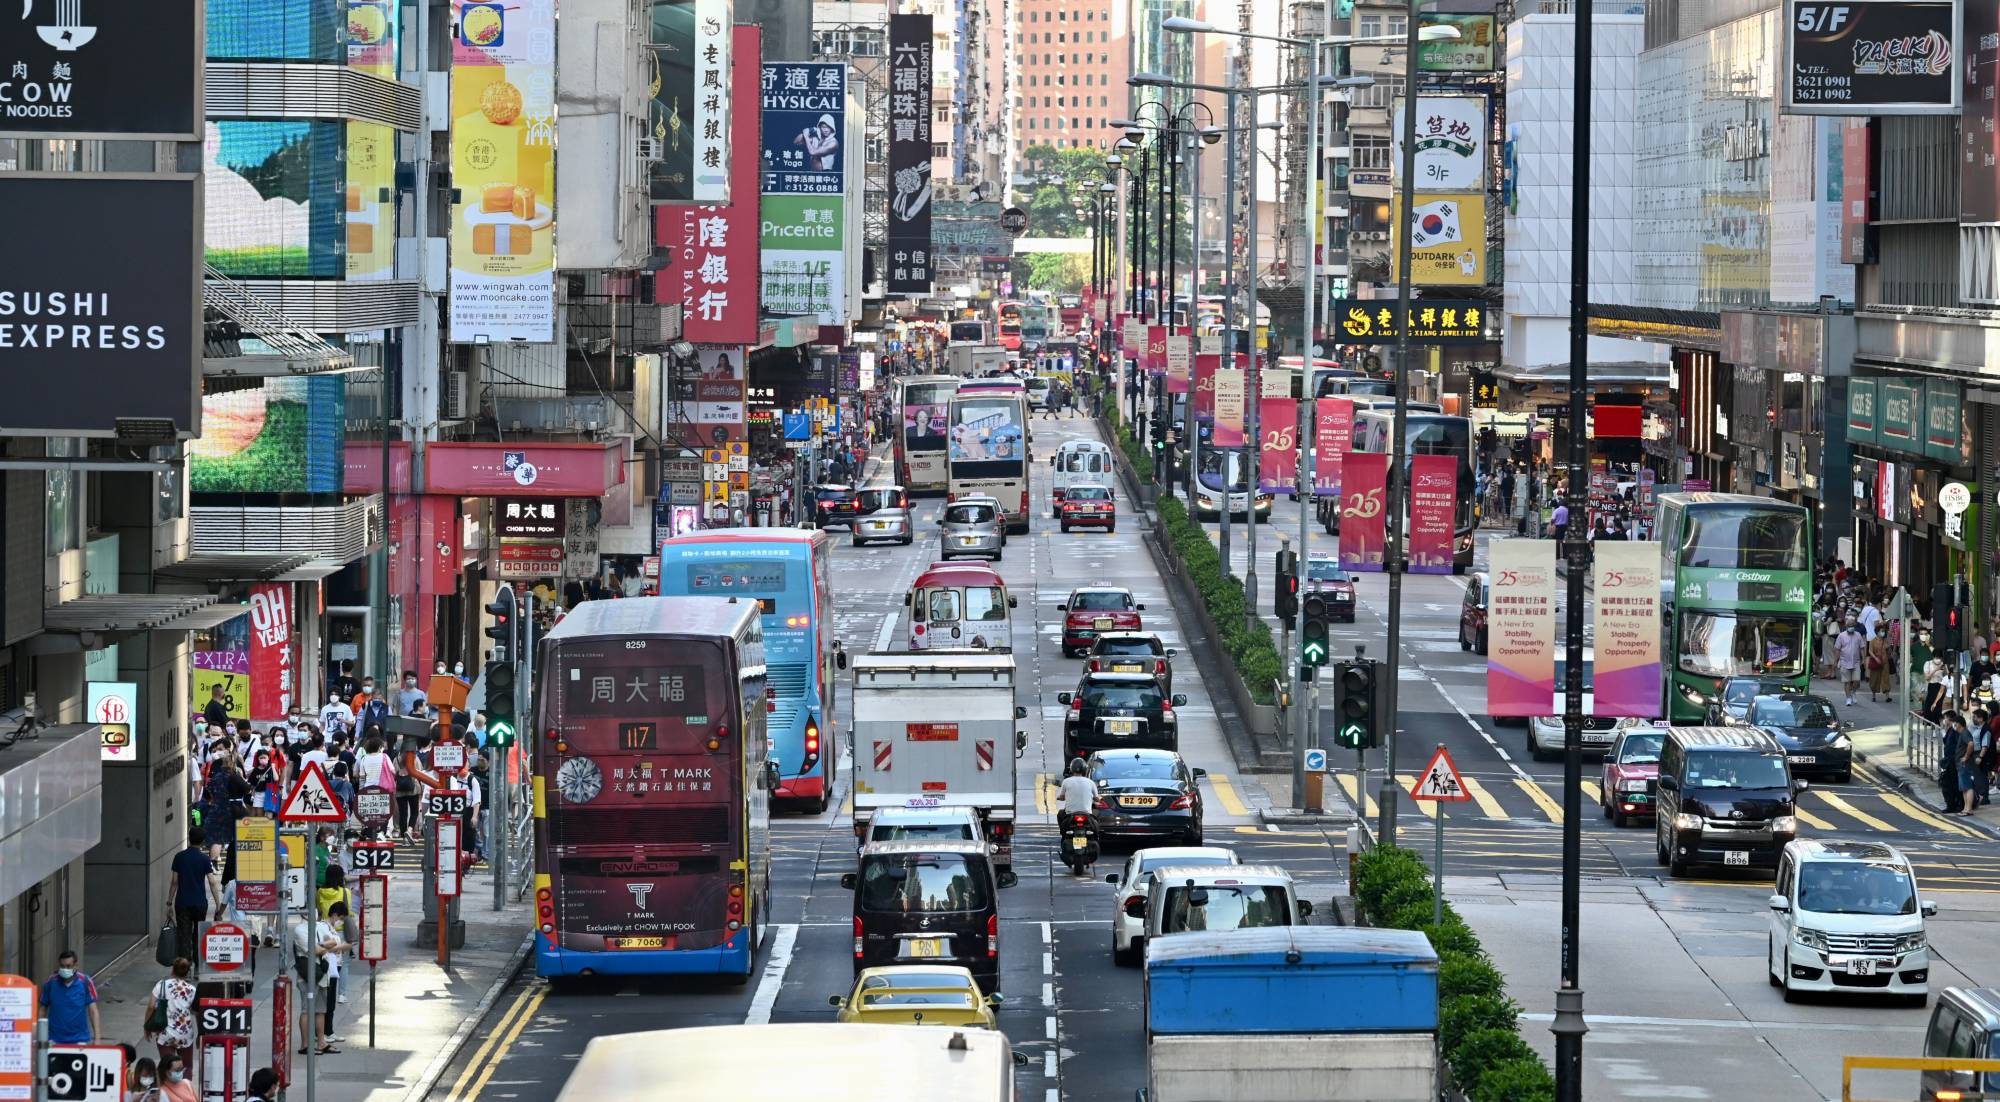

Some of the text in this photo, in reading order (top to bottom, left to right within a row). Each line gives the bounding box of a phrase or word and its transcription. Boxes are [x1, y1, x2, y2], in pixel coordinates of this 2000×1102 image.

[1797, 7, 1849, 32] 5/F
[1853, 35, 1932, 66] DAIEIKI
[12, 60, 72, 80] 肉麵
[1807, 66, 1830, 74] TEL:
[1796, 77, 1851, 87] 3621 0901
[0, 82, 72, 103] COW
[893, 42, 918, 142] 六福珠寶
[919, 42, 930, 143] LUKFOOK JEWELLERY
[1796, 89, 1852, 99] 3621 0902
[7, 105, 72, 117] NOODLES
[702, 43, 723, 169] 老鳳祥銀樓
[783, 159, 803, 168] Yoga
[1427, 164, 1449, 181] 3/F
[792, 184, 838, 192] 3126 0888
[802, 208, 834, 223] 實惠
[762, 221, 834, 237] Pricerite
[697, 205, 729, 322] 隆銀行
[1411, 252, 1455, 261] OUTDARK
[684, 211, 695, 321] LUNG BANK
[803, 260, 831, 278] 1/F
[455, 282, 549, 293] www.wingwah.com
[765, 282, 829, 297] 即將開幕
[0, 291, 109, 316] SUSHI
[455, 294, 549, 302] www.mooncake.com
[803, 302, 829, 311] SOON
[1377, 308, 1480, 328] 老祥銀樓
[0, 324, 166, 350] EXPRESS
[1416, 475, 1432, 486] 25
[756, 501, 771, 509] S17
[1601, 503, 1617, 511] N62
[1496, 571, 1518, 586] 25
[1602, 571, 1625, 587] 25
[1736, 571, 1771, 582] Cestbon
[250, 587, 287, 630] OH
[1504, 630, 1532, 638] Stability
[1611, 631, 1638, 639] Stability
[625, 641, 646, 649] 8259
[1511, 639, 1545, 648] Prosperity
[1617, 640, 1651, 648] Prosperity
[193, 651, 249, 665] EXTRA
[1499, 647, 1541, 656] Opportunity
[1605, 648, 1647, 657] Opportunity
[200, 683, 205, 691] 3
[223, 674, 234, 691] 7
[591, 676, 685, 703] 周大福
[223, 695, 234, 712] 8
[627, 727, 649, 748] 117
[613, 768, 712, 780] 周大福 T MARK
[612, 781, 712, 792] 天然鑽石最佳保證
[432, 796, 465, 812] S13
[355, 849, 392, 867] S12
[586, 924, 623, 933] Exclusively
[634, 923, 659, 931] CHOW
[673, 922, 696, 930] FOOK
[637, 938, 662, 946] 7060
[1855, 967, 1868, 976] 33
[202, 1008, 246, 1030] S11
